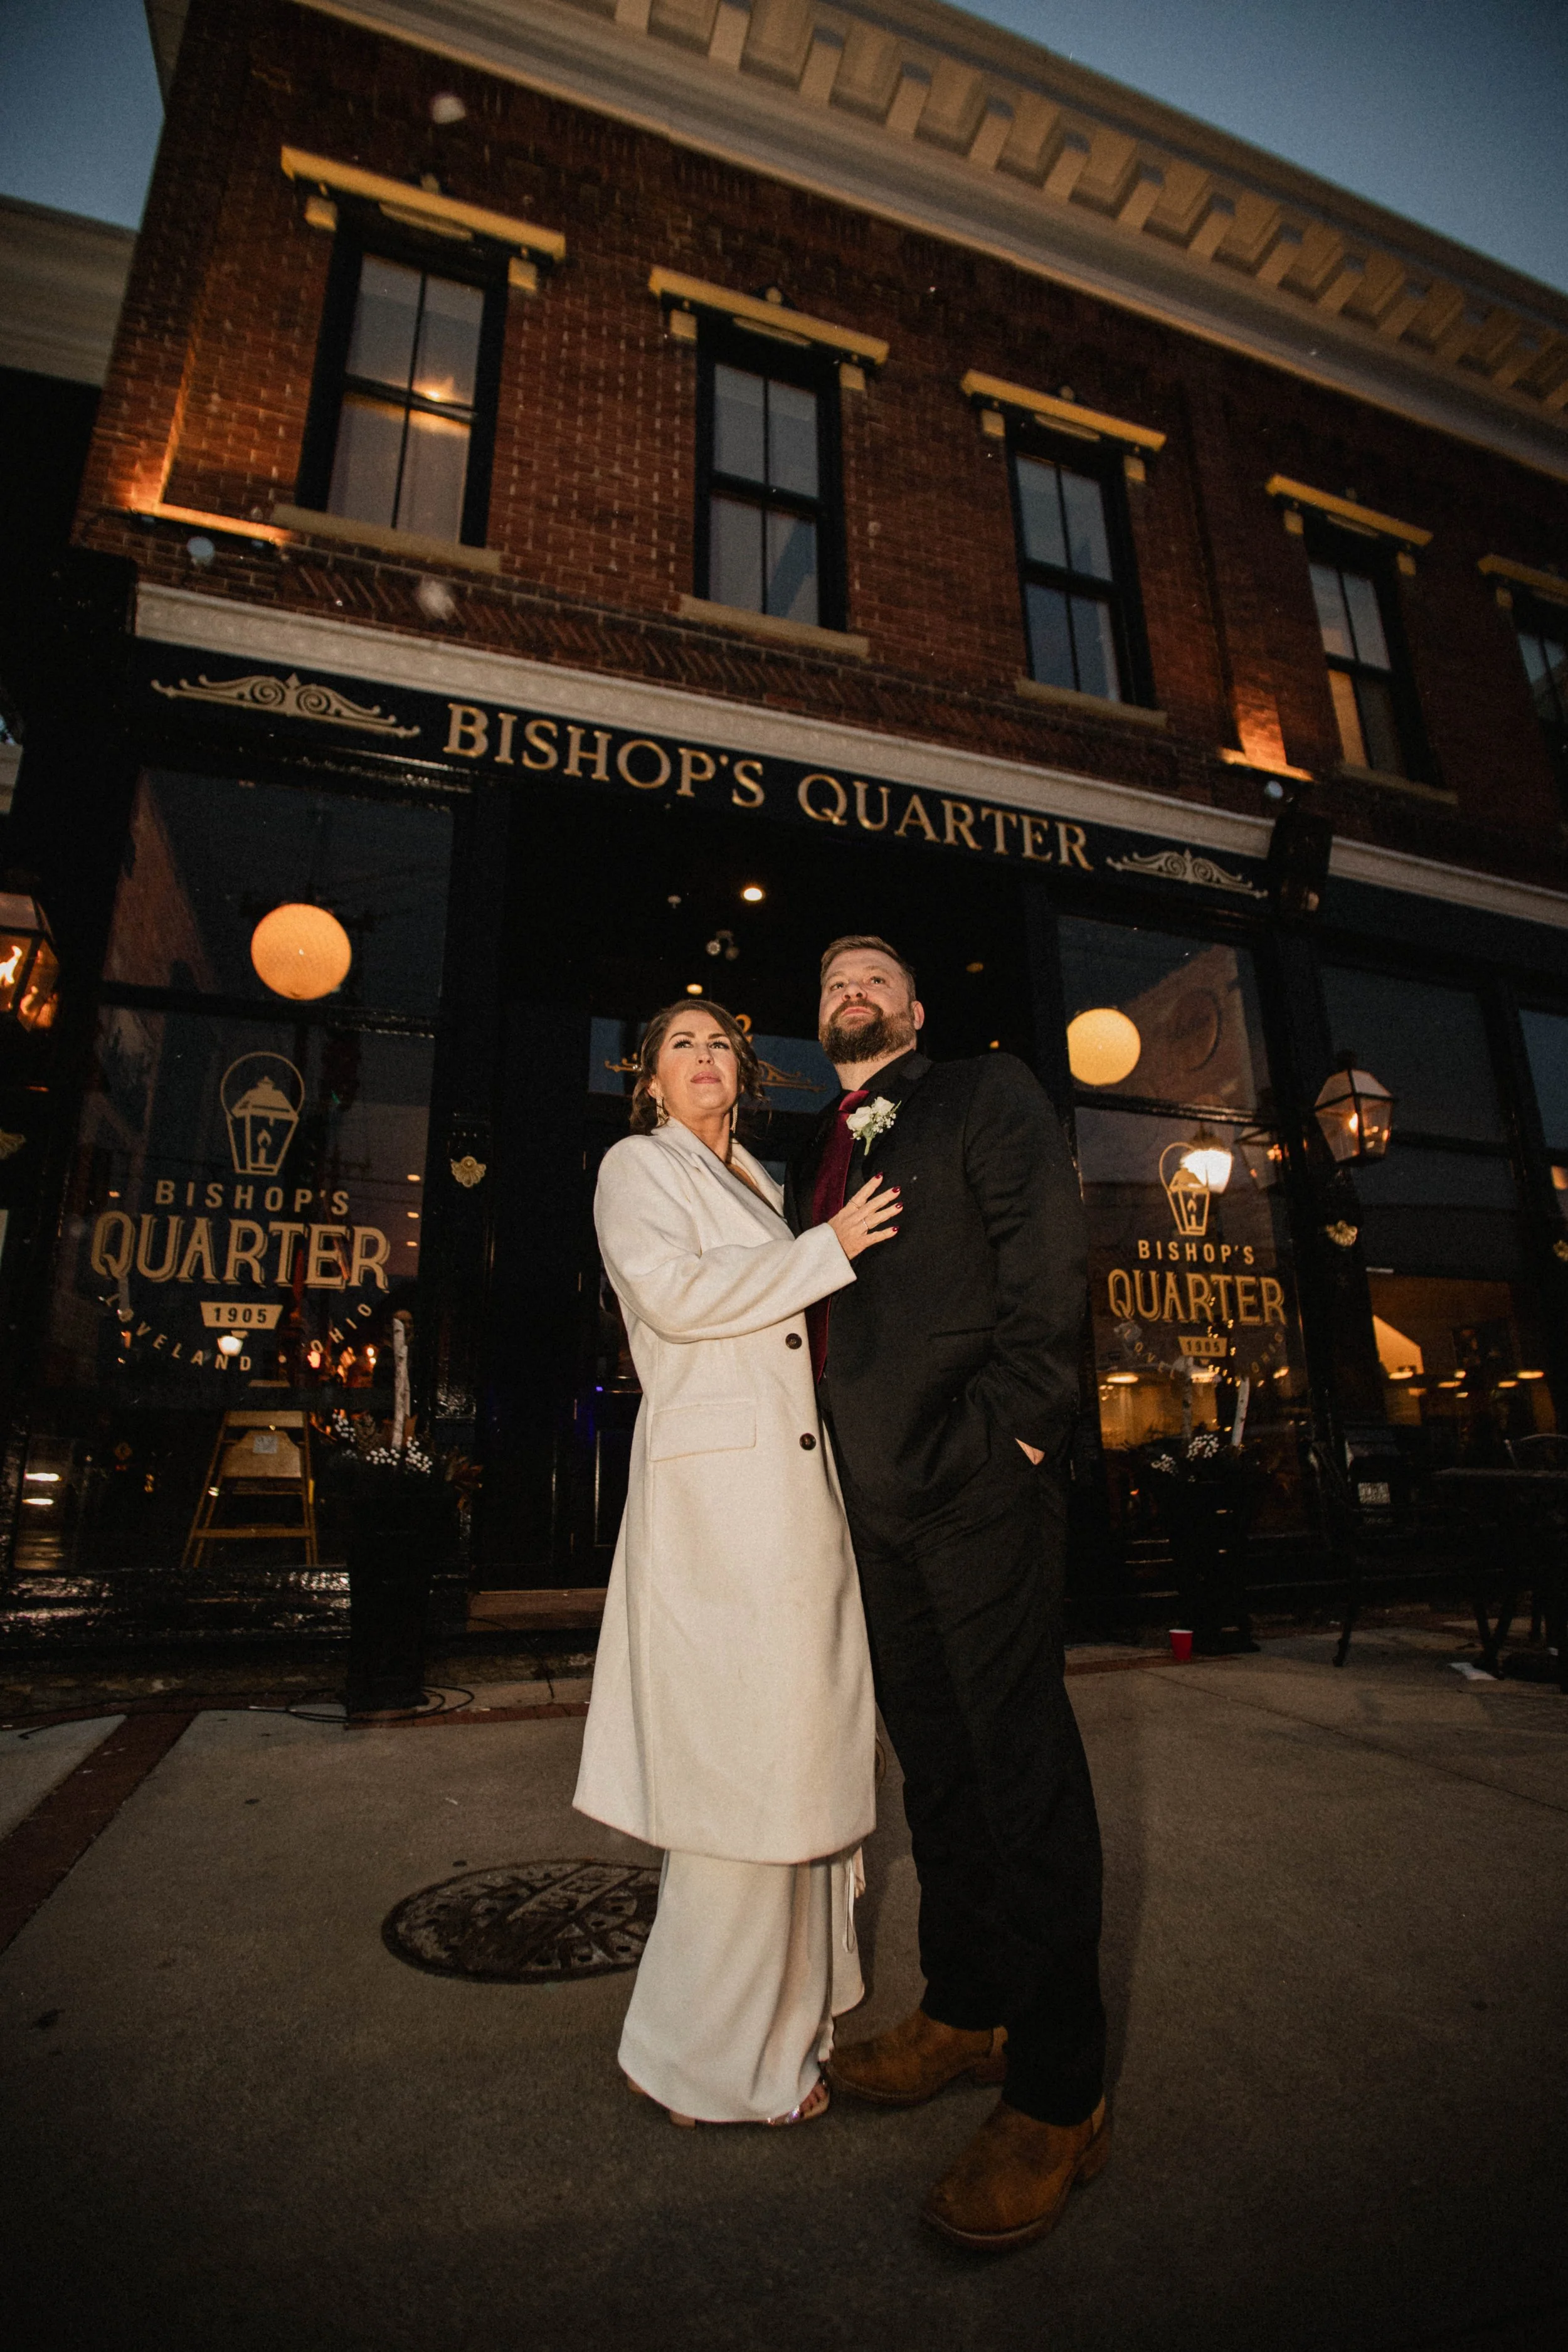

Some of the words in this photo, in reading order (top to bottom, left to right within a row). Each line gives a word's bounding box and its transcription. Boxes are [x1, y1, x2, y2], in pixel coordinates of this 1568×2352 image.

[442, 702, 766, 810] BISHOP'S
[797, 772, 1093, 872] QUARTER
[155, 1179, 351, 1217] BISHOP'S
[90, 1210, 390, 1294] QUARTER
[1136, 1238, 1255, 1266] BISHOP'S
[213, 1306, 268, 1324] 1905
[1107, 1268, 1288, 1327] QUARTER
[310, 1303, 373, 1355] OHIO
[1187, 1339, 1221, 1353] 1905
